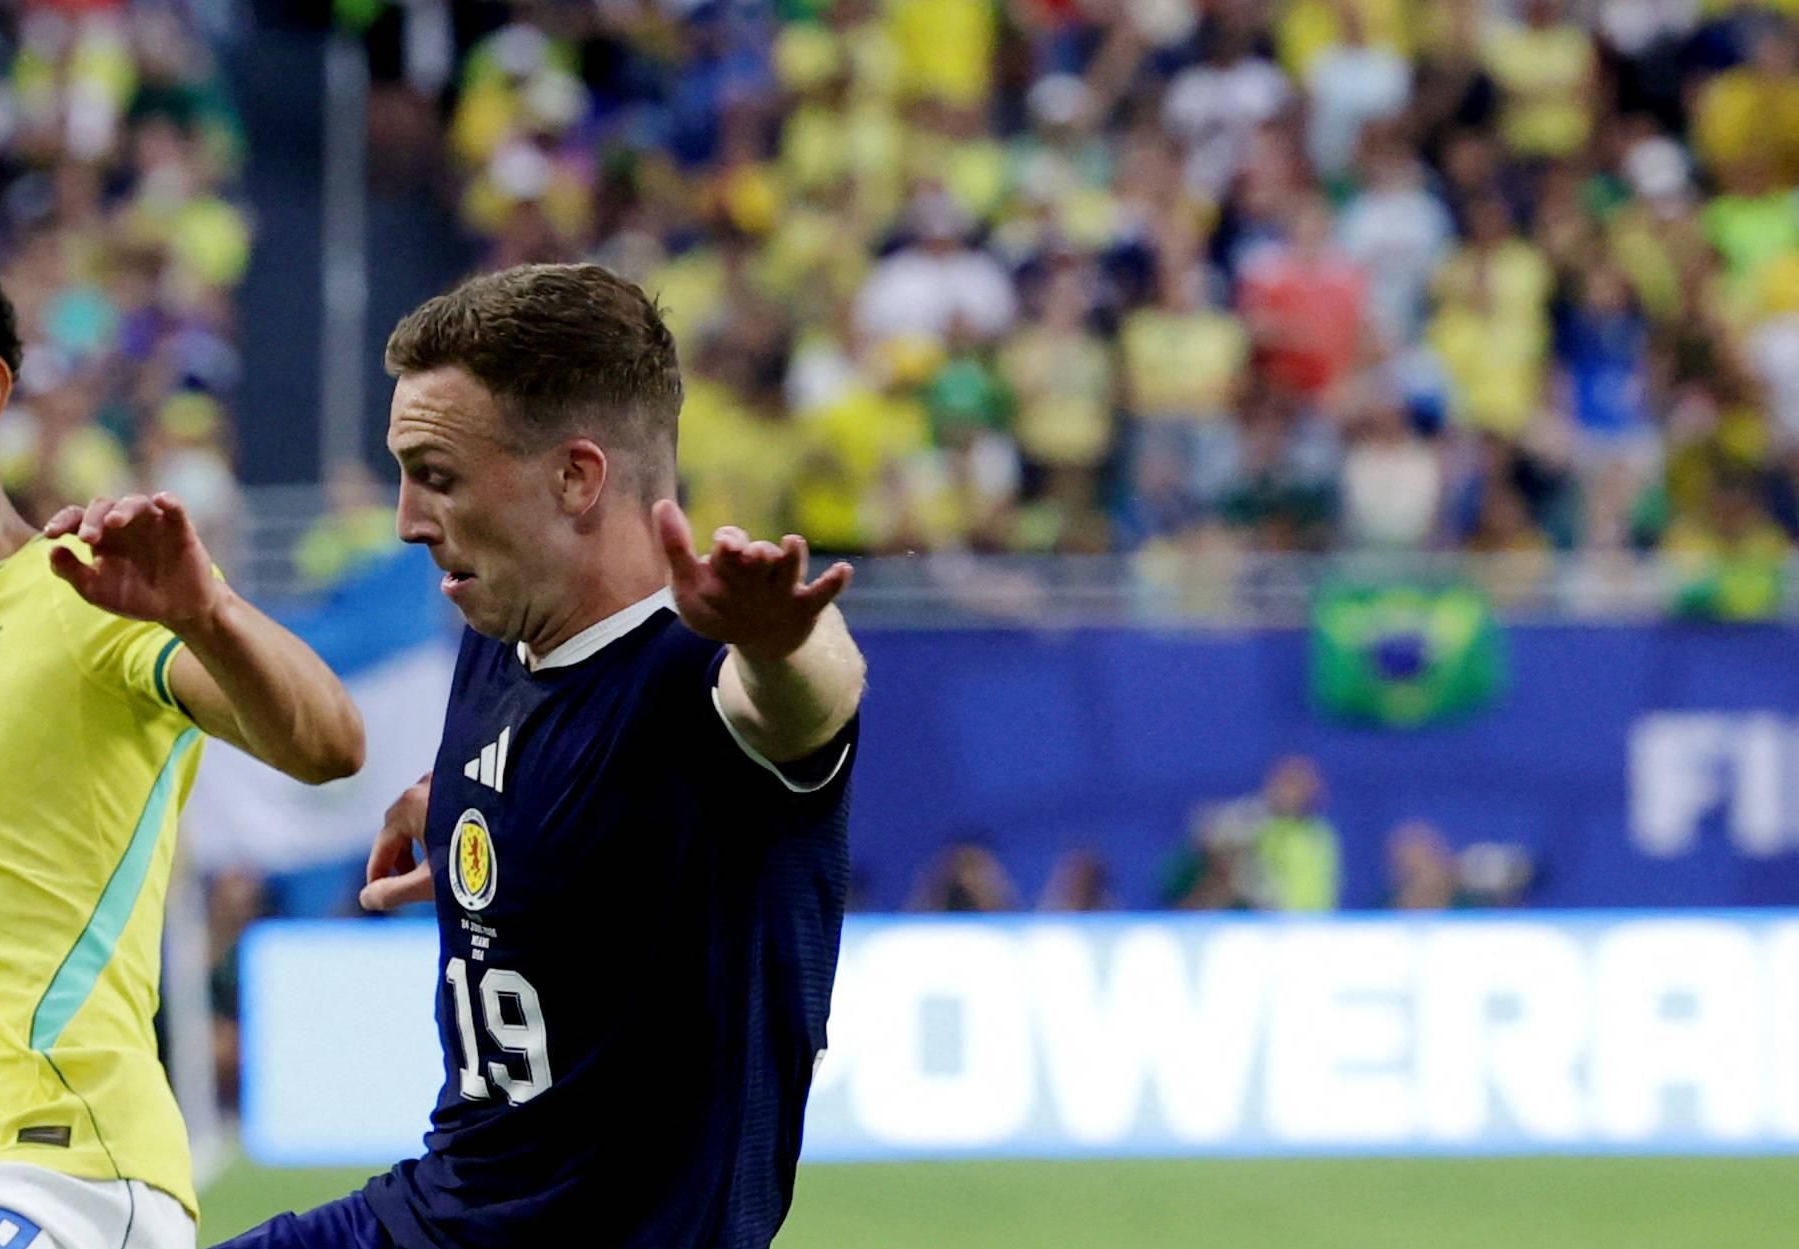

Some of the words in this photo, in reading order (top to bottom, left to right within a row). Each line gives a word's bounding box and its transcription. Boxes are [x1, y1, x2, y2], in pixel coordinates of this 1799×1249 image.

[1627, 712, 1799, 857] FI
[445, 957, 553, 1107] 19
[814, 916, 1799, 1148] OWERA
